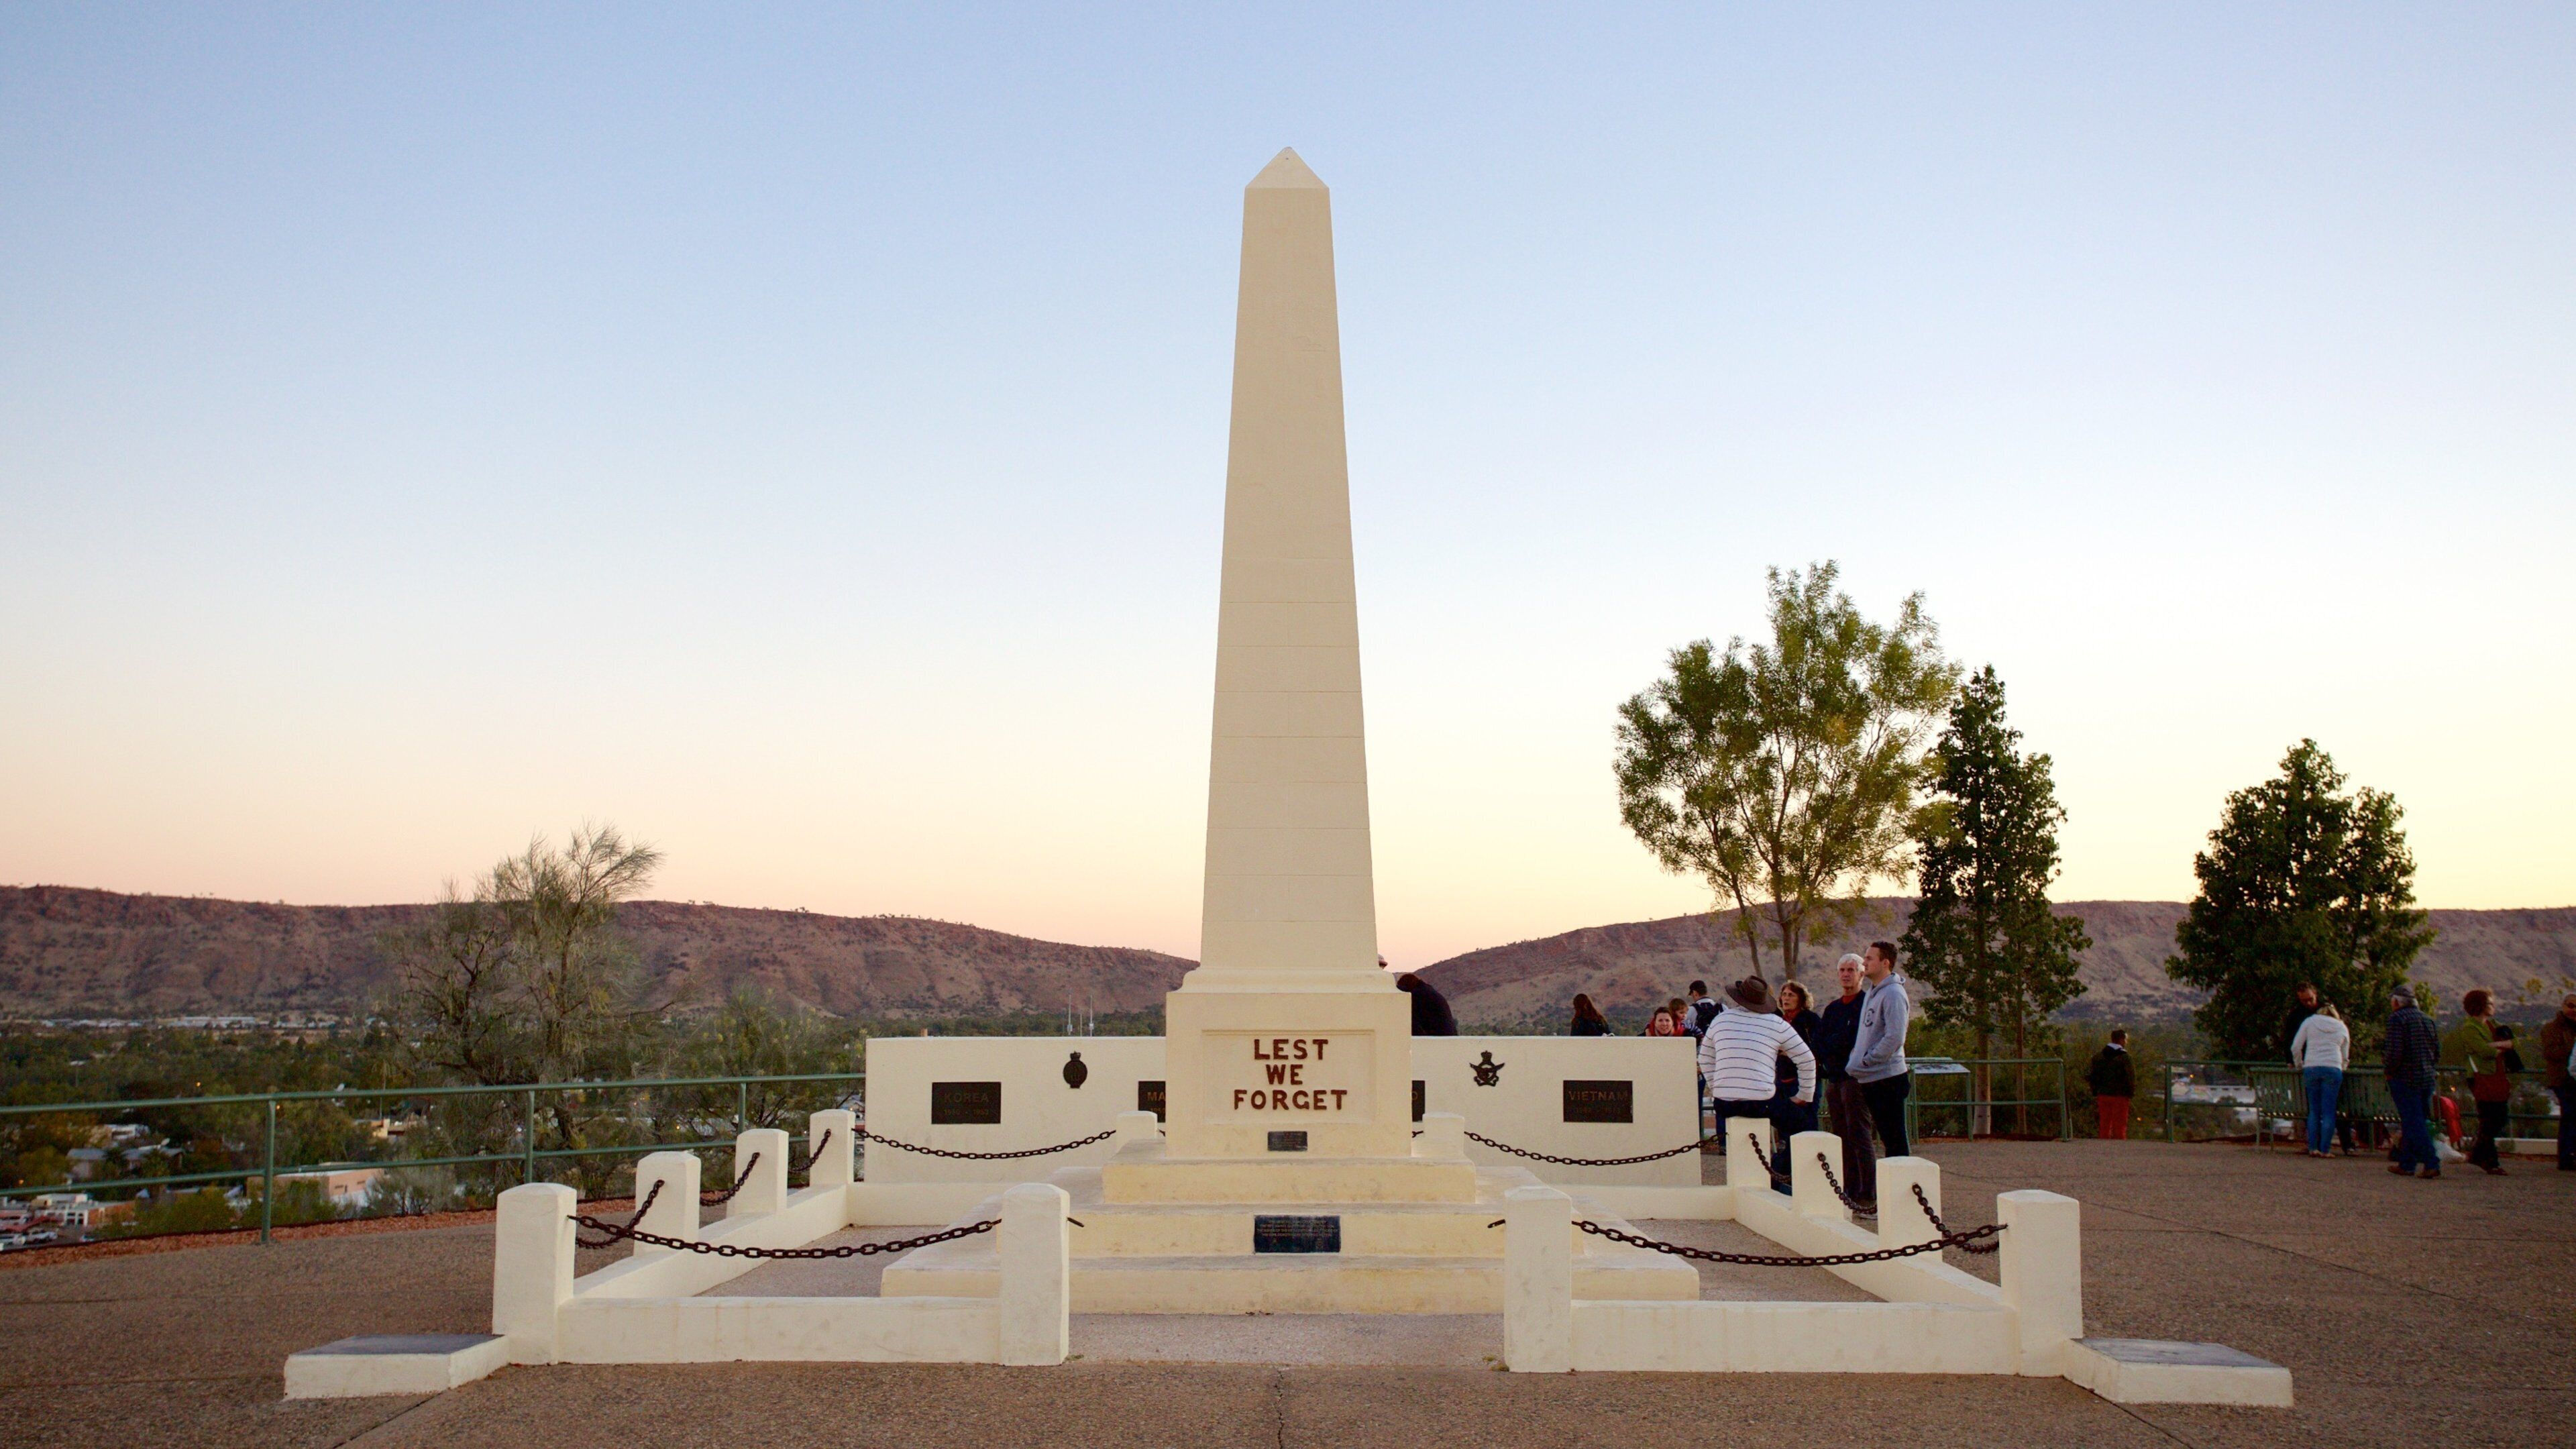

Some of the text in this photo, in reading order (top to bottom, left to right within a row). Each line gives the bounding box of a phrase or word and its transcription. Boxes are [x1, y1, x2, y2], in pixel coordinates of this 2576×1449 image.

[1254, 1038, 1329, 1060] LEST
[1265, 1064, 1303, 1085] WE
[944, 1092, 989, 1103] KOREA
[1234, 1089, 1348, 1110] FORGET
[1568, 1090, 1627, 1101] VIETNAM
